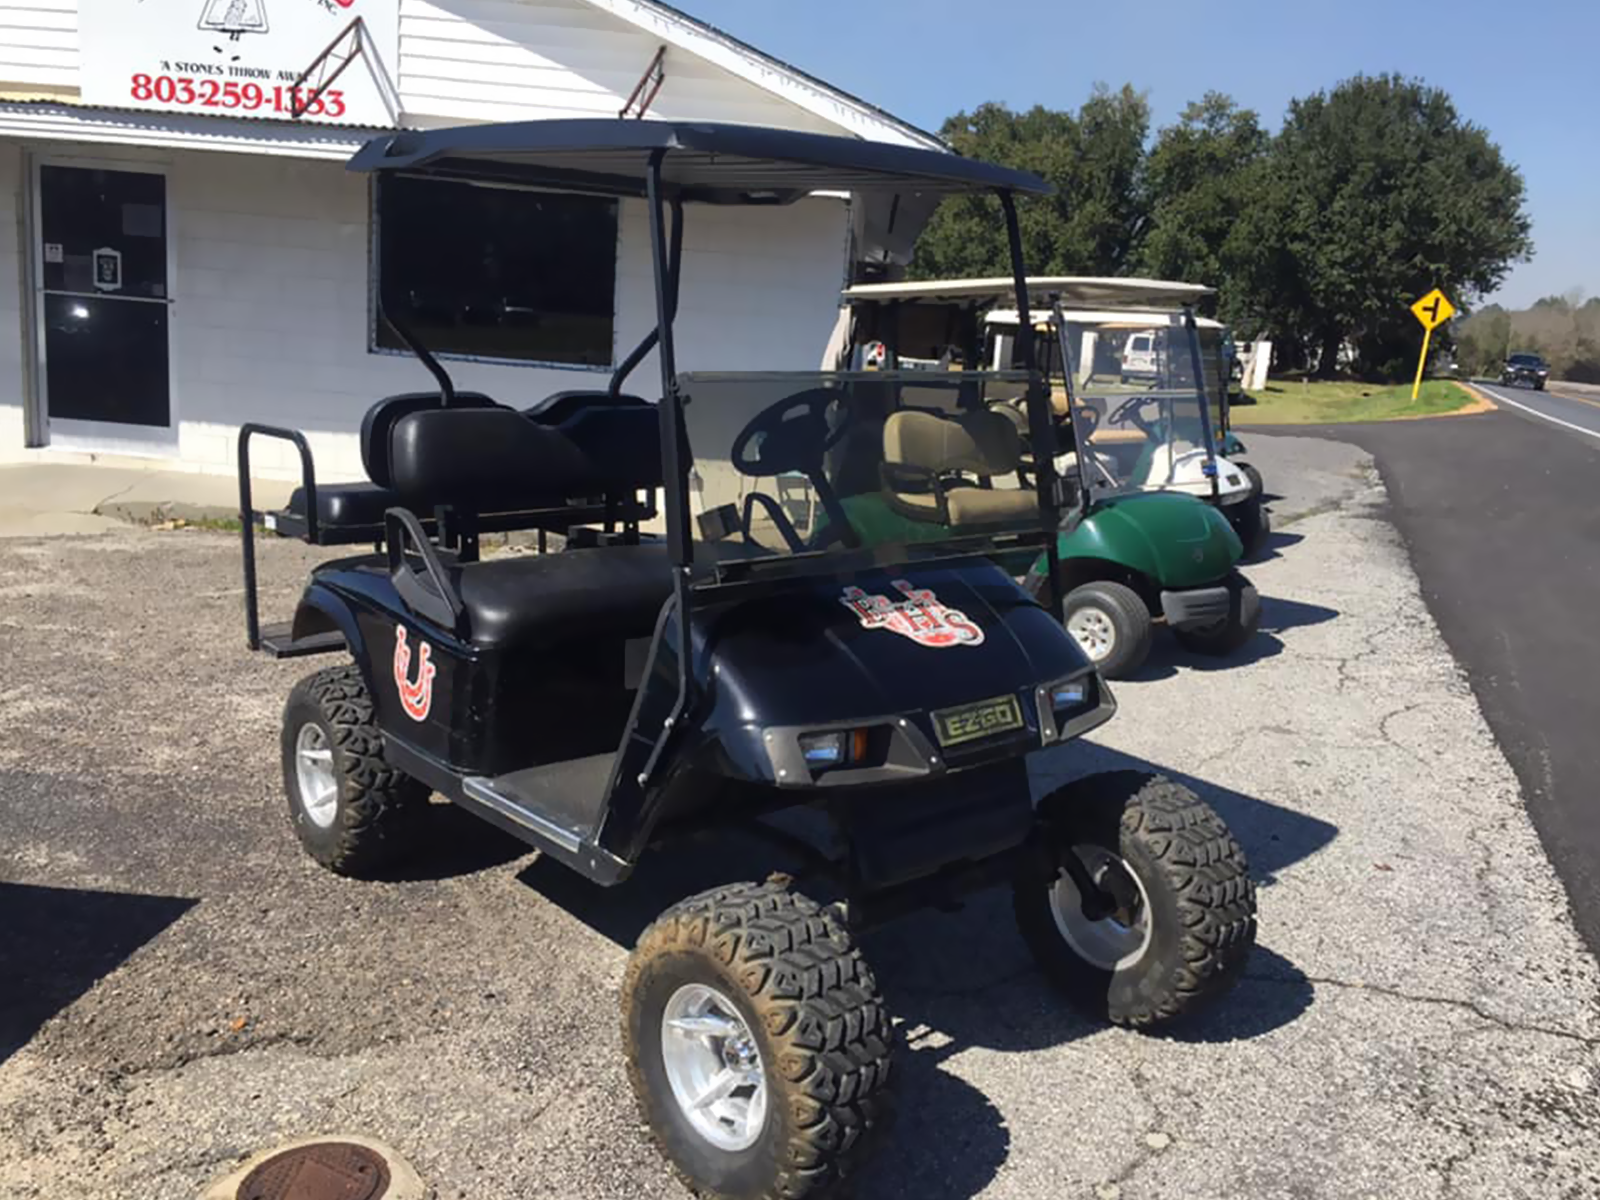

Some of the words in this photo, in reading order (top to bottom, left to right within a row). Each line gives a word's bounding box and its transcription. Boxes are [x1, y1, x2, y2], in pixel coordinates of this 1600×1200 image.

[174, 61, 224, 75] STONES
[227, 65, 271, 80] THROW
[130, 73, 346, 117] 803-259-1353
